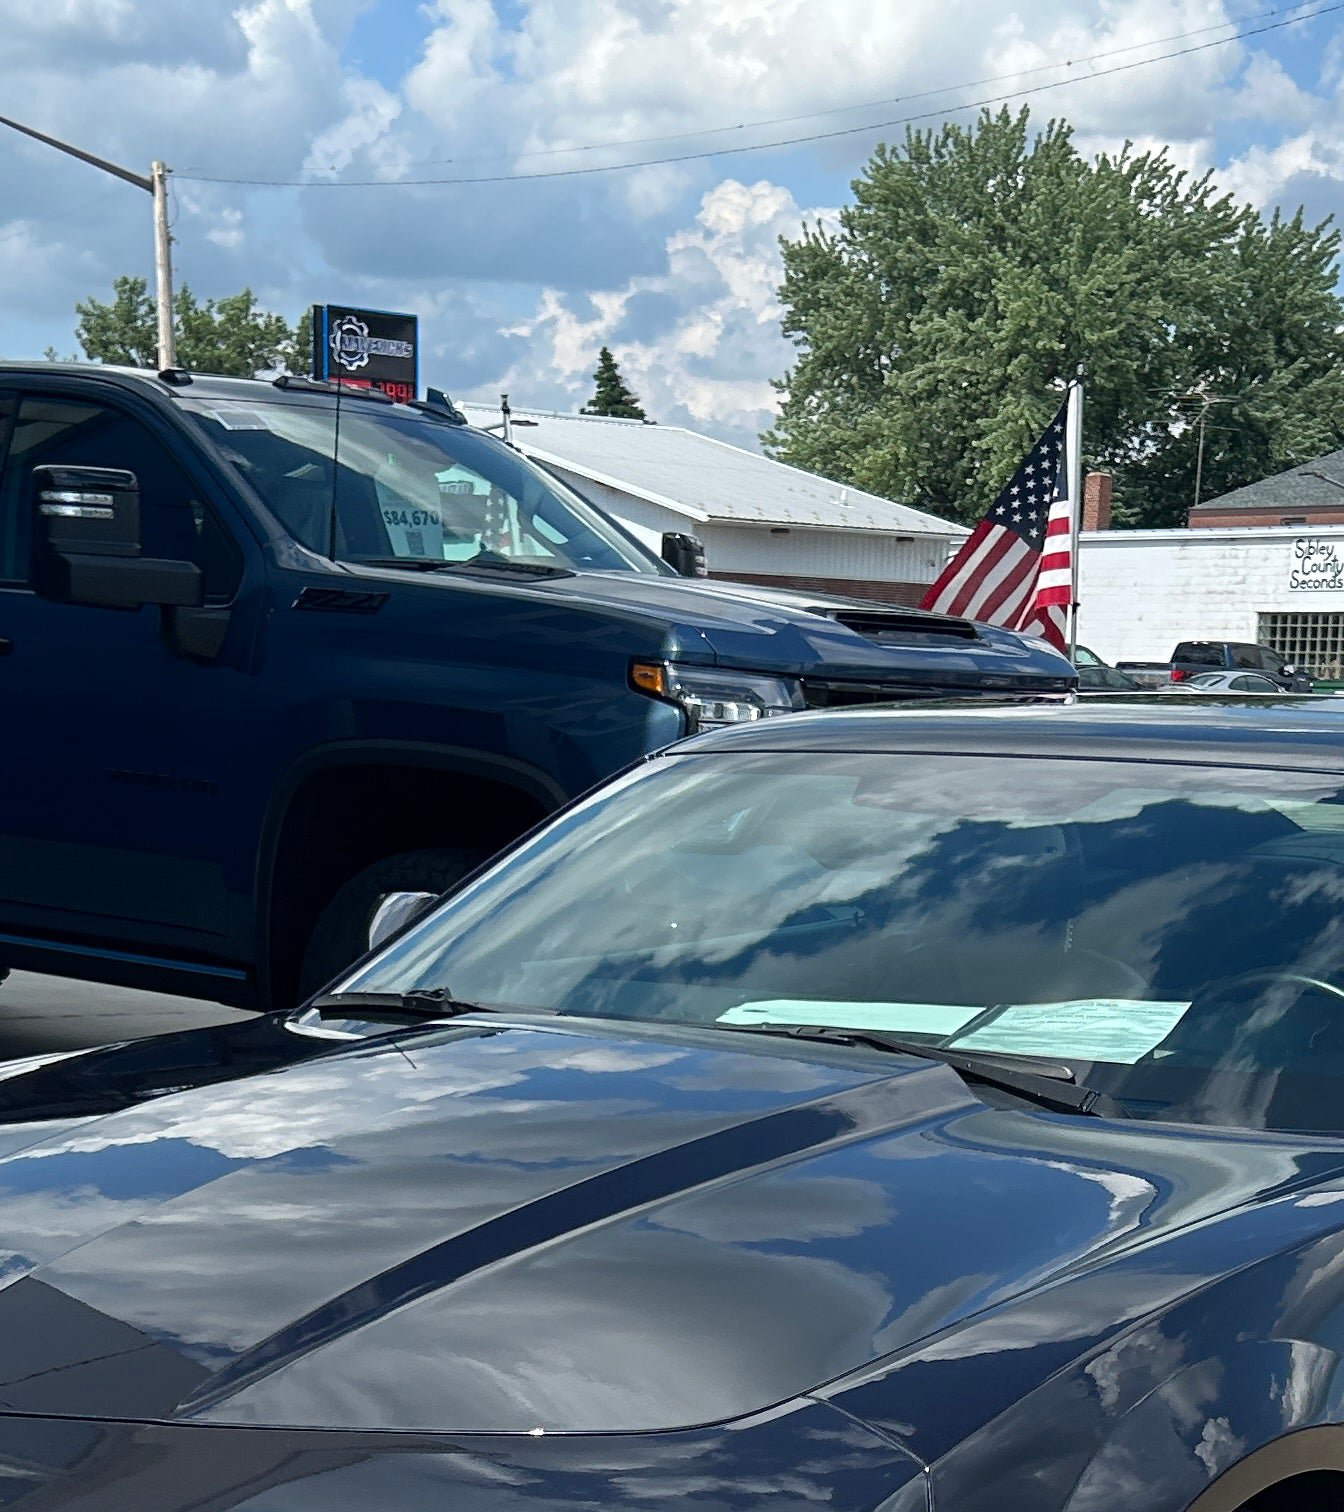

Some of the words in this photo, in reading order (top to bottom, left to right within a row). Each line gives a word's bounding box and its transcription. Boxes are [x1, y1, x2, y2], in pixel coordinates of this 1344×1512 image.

[1295, 538, 1335, 561] Sibley
[1302, 555, 1344, 579] County
[1289, 569, 1344, 589] Seconds
